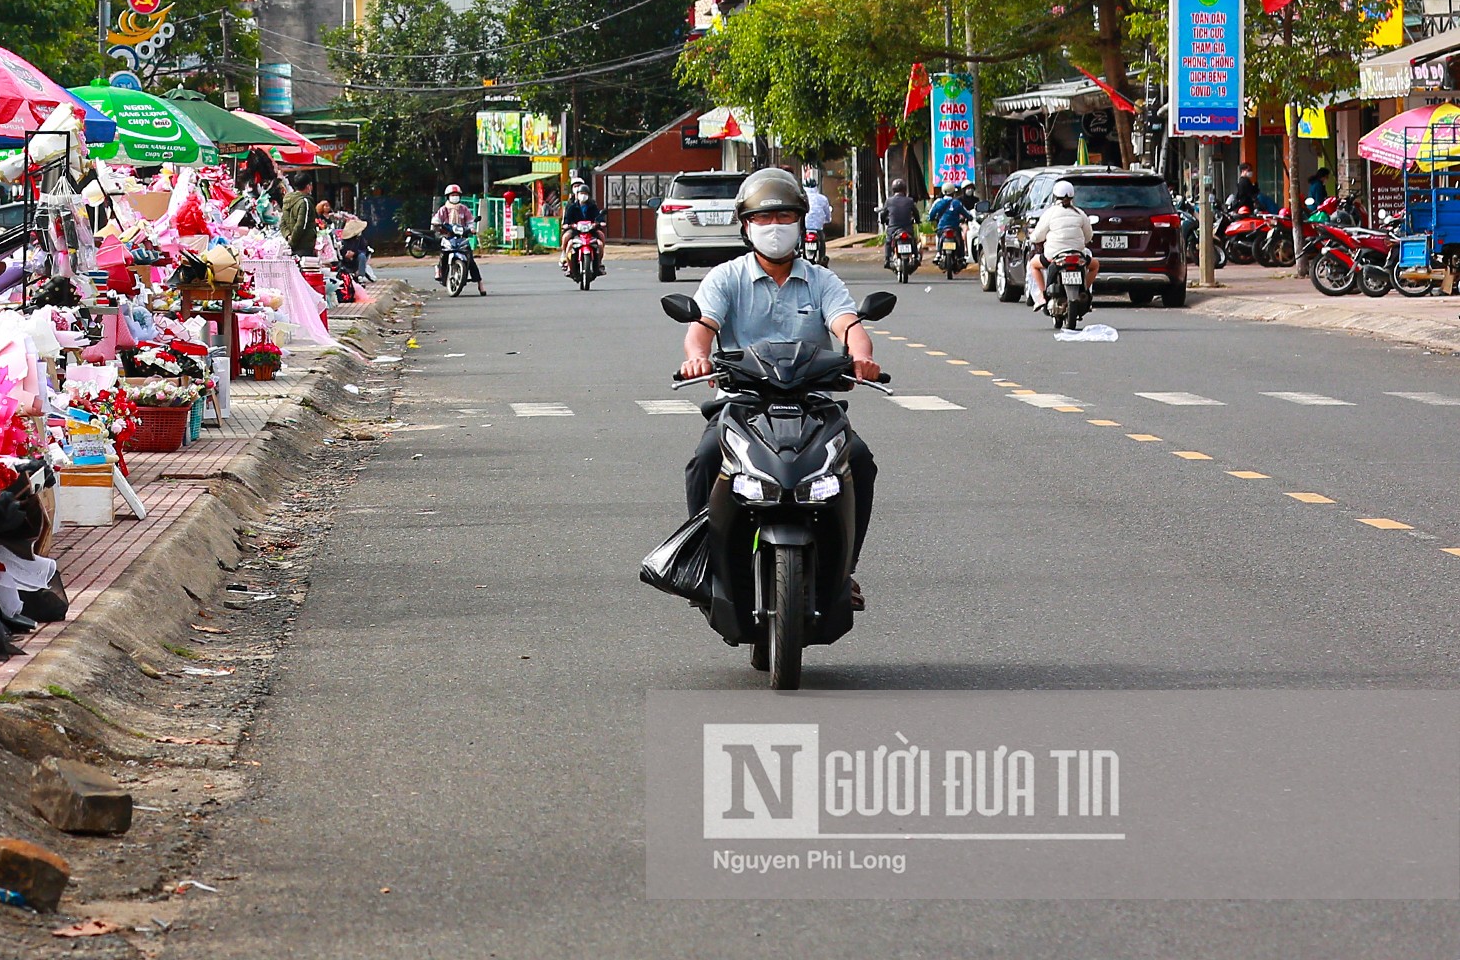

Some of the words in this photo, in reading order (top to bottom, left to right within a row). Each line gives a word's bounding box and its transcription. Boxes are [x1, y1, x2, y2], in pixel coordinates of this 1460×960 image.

[1191, 41, 1212, 54] THAM
[1213, 42, 1226, 54] GIA
[1190, 85, 1211, 97] COVID
[1218, 85, 1227, 97] 19
[1180, 113, 1237, 125] mobifone
[942, 169, 967, 182] 2022
